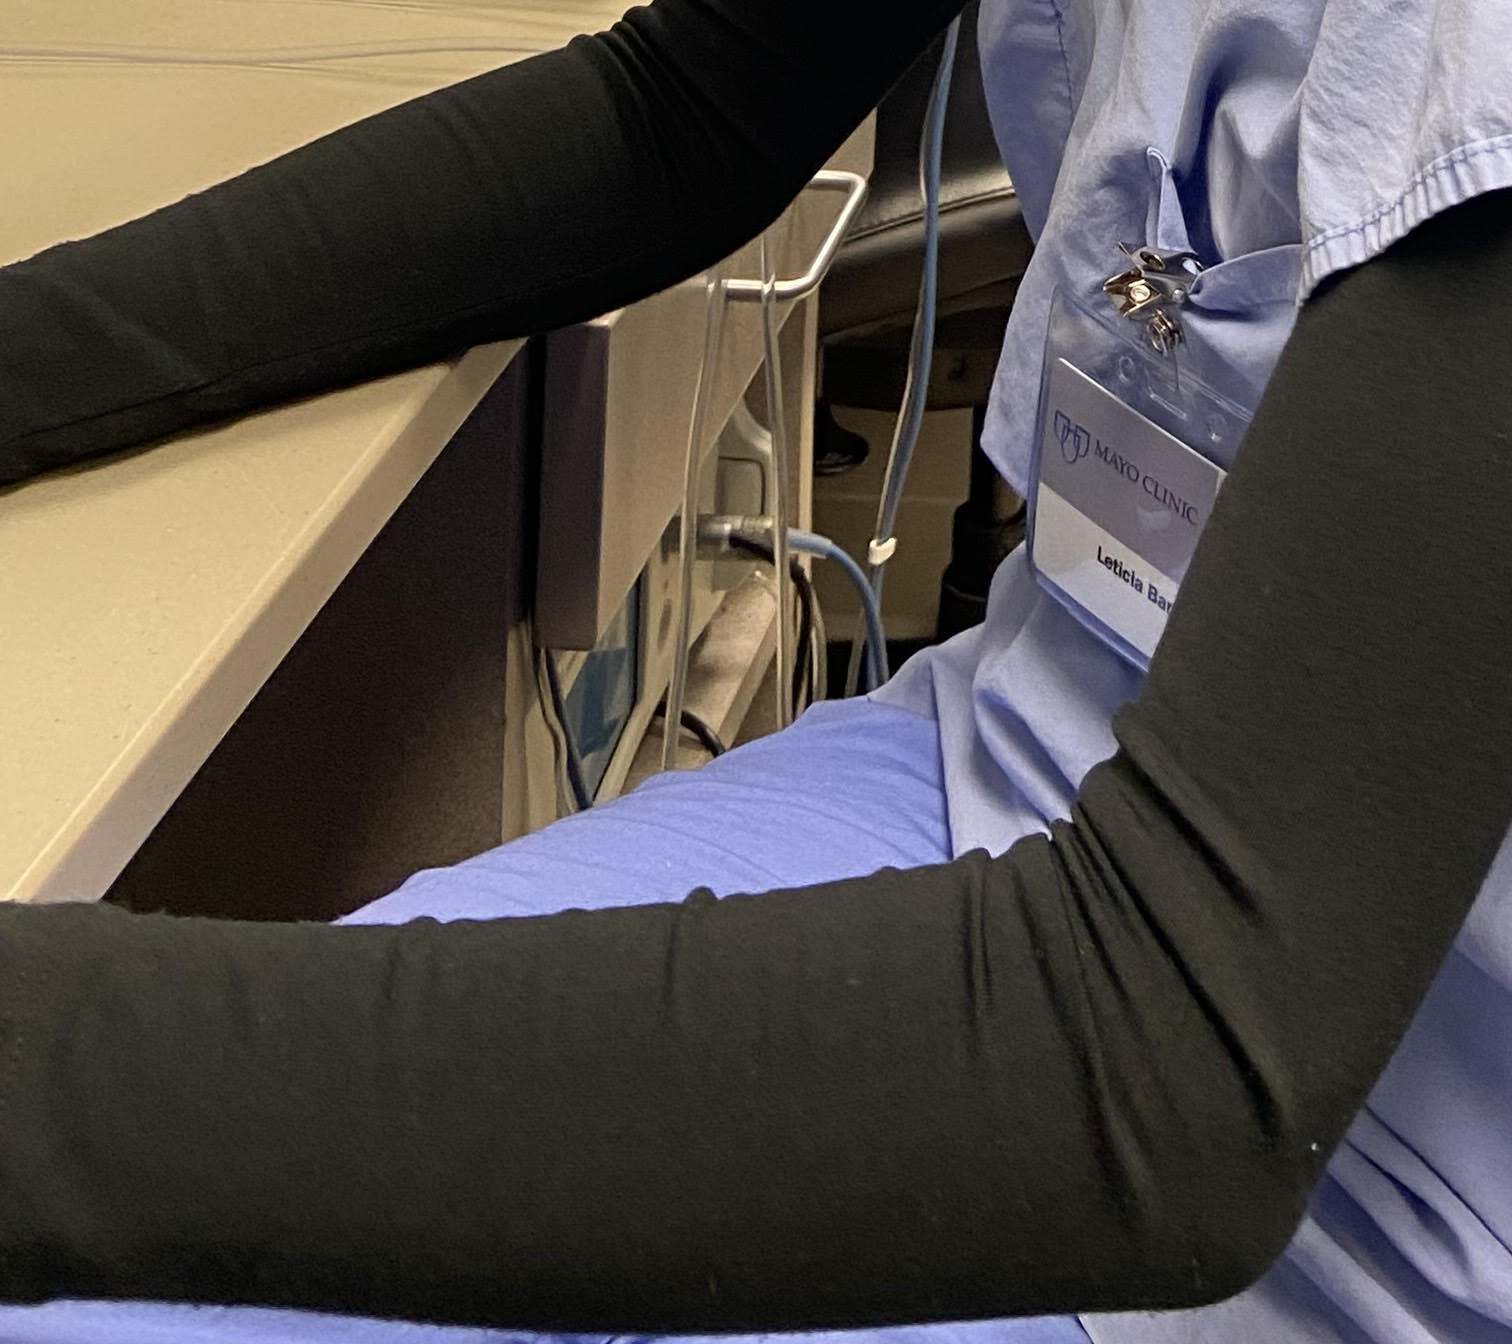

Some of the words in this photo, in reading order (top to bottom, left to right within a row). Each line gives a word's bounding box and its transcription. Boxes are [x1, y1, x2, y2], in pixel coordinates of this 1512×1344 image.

[1094, 439, 1140, 483] MAYO
[1142, 475, 1198, 526] CLINIC
[1097, 545, 1144, 594] Leticia
